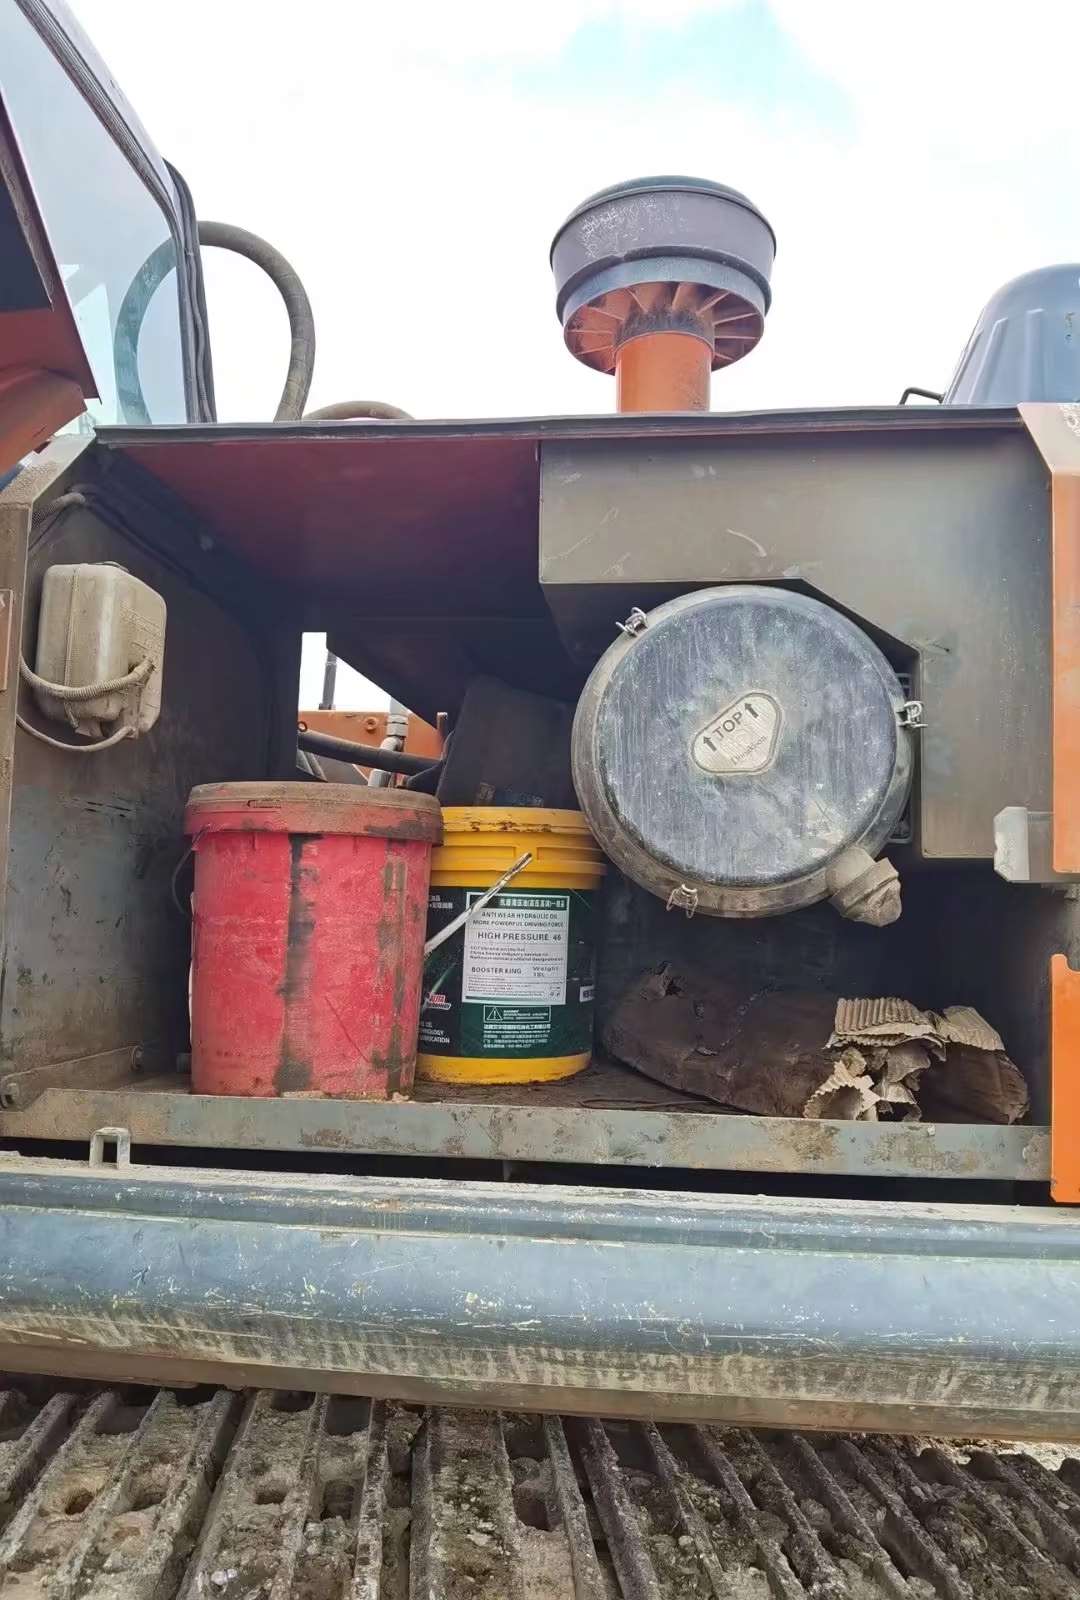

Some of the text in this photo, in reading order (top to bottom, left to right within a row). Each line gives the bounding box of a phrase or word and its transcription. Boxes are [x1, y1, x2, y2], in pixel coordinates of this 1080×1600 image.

[712, 711, 742, 738] TOP
[478, 931, 501, 940] HIGH
[503, 932, 550, 941] PRESSURE
[471, 966, 522, 975] BOOSTER KING
